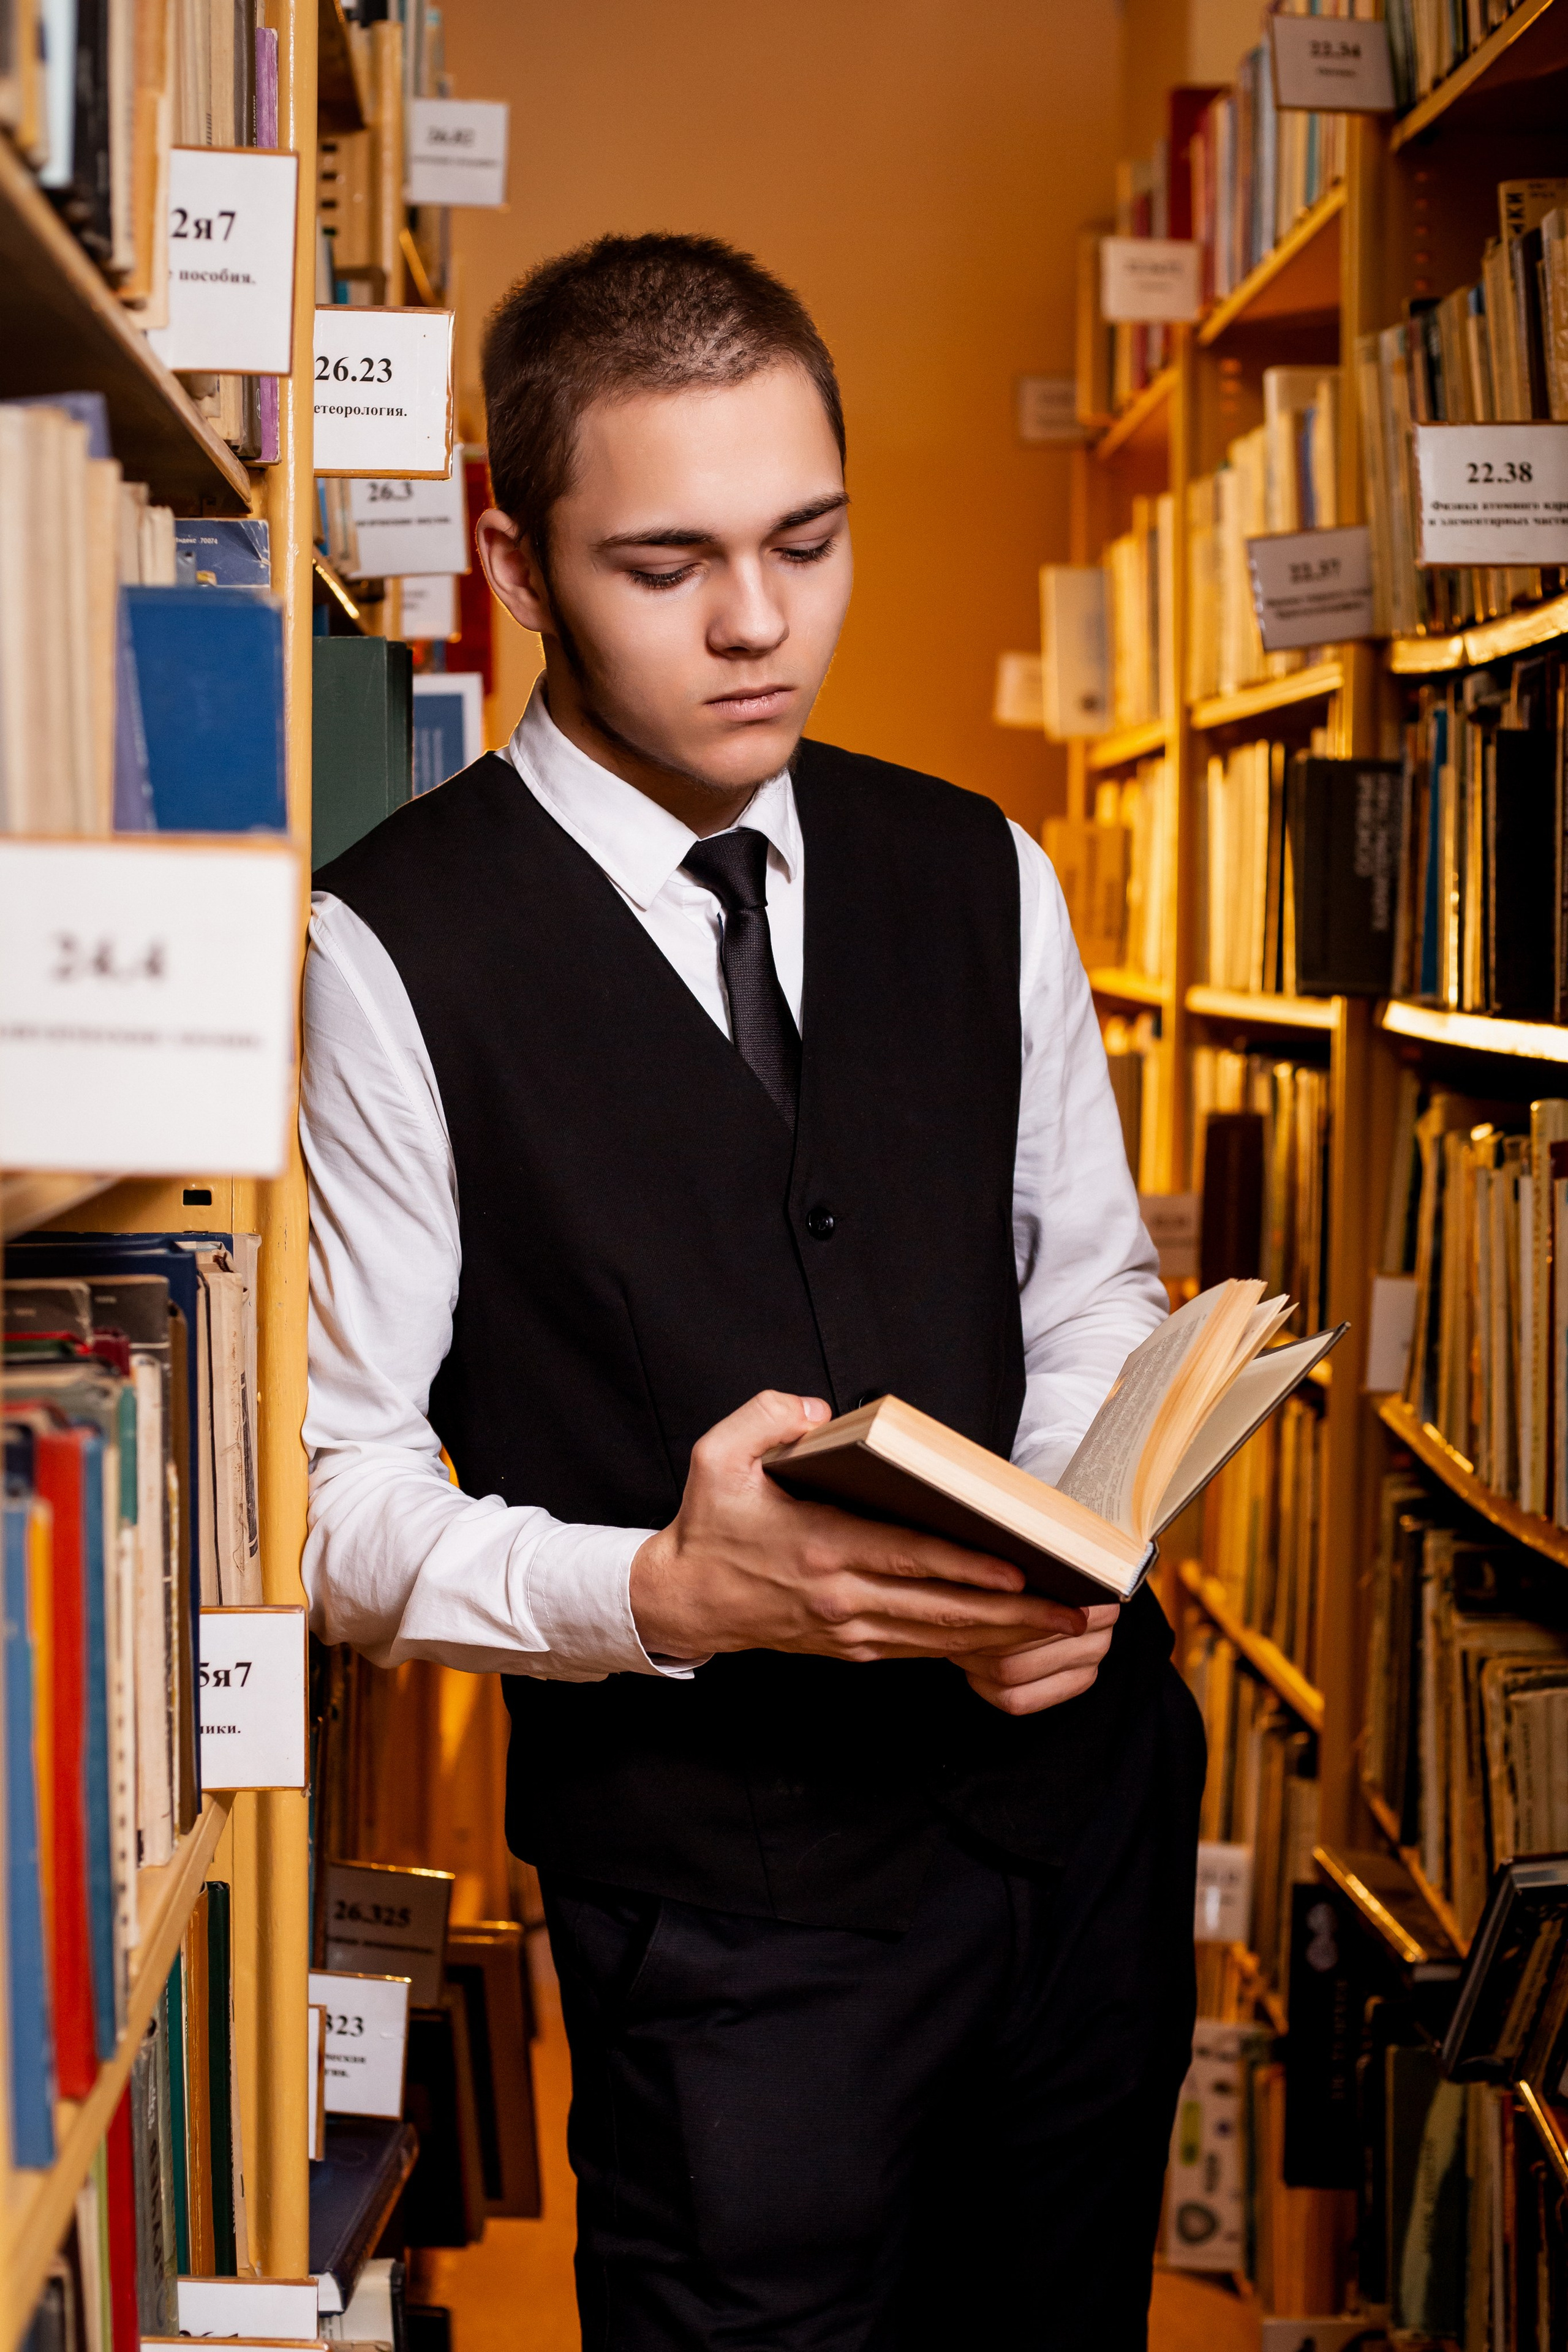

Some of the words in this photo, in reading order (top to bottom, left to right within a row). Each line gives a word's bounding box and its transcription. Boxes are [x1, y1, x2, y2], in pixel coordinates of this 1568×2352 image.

[171, 207, 236, 241] 2я7
[179, 268, 256, 284] пособия.
[315, 356, 392, 383] 26.23
[314, 405, 407, 418] етеорология.
[1467, 461, 1533, 484] 22.38
[1431, 500, 1478, 511] Физика
[1482, 502, 1540, 511] атомного
[1441, 518, 1529, 530] элементарных
[335, 1901, 410, 1928] 26.325
